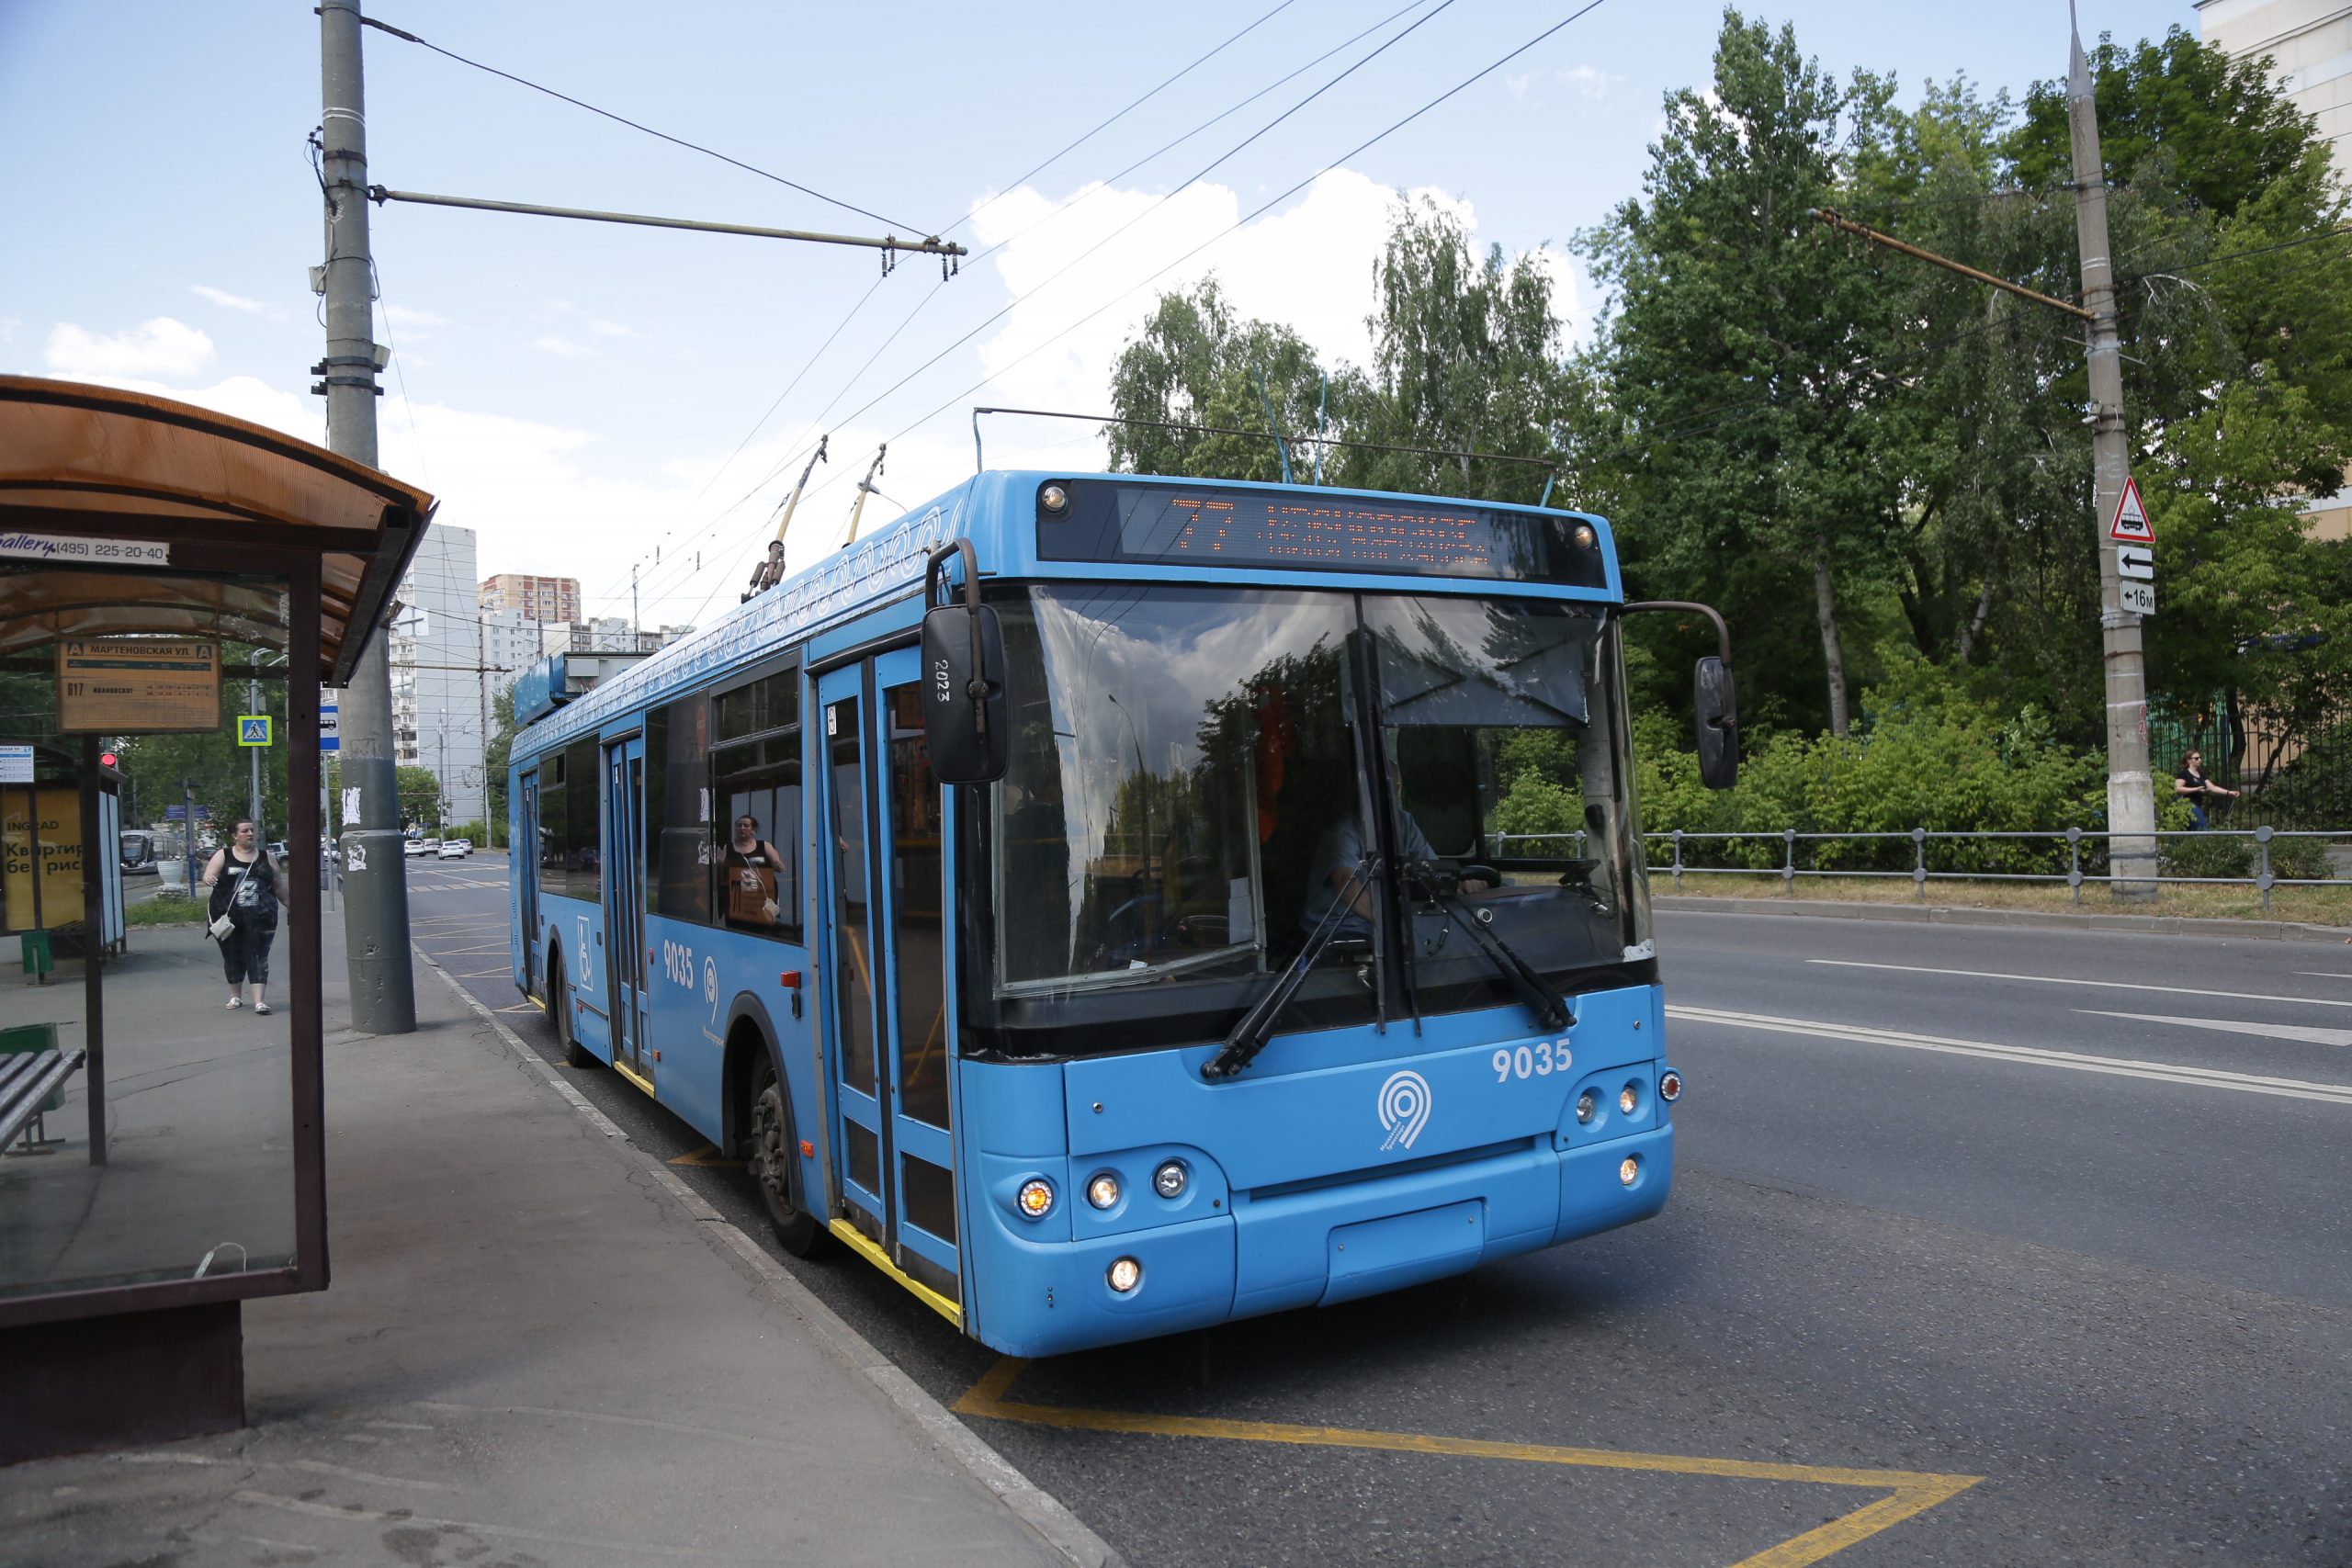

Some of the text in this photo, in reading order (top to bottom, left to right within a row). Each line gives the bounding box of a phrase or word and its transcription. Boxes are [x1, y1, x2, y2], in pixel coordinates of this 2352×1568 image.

[1172, 499, 1235, 551] 77
[56, 542, 89, 556] (495)
[95, 544, 164, 559] 225-20-40
[91, 645, 173, 656] МАРТЕНОВСКАЯ
[175, 647, 191, 657] УЛ.
[934, 659, 950, 702] 2023
[7, 820, 60, 831] INGAD
[7, 859, 37, 874] бе
[663, 939, 694, 989] 9035
[1492, 1038, 1573, 1083] 9035
